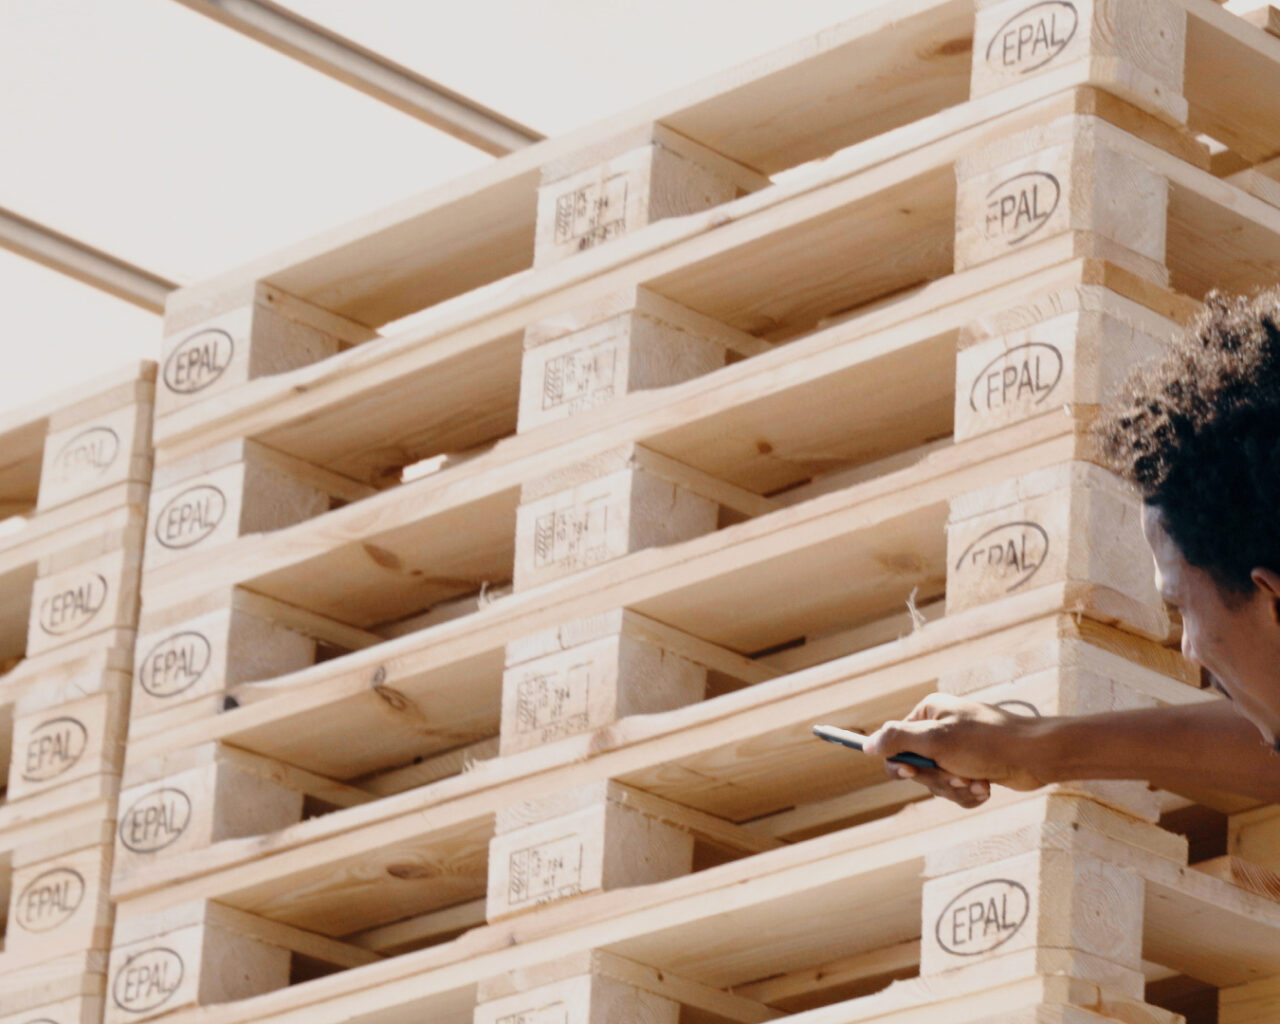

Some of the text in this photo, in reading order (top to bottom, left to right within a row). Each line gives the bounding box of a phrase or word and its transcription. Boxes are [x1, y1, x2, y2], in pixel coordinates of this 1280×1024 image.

[1003, 13, 1065, 66] EPAL
[174, 341, 224, 385] EPAL
[166, 496, 217, 540] EPAL
[50, 583, 99, 627] EPAL
[151, 643, 201, 688] EPAL
[26, 730, 78, 773] EPAL
[131, 800, 183, 844] EPAL
[952, 894, 1017, 946] EPAL
[124, 960, 175, 1003] EPAL
